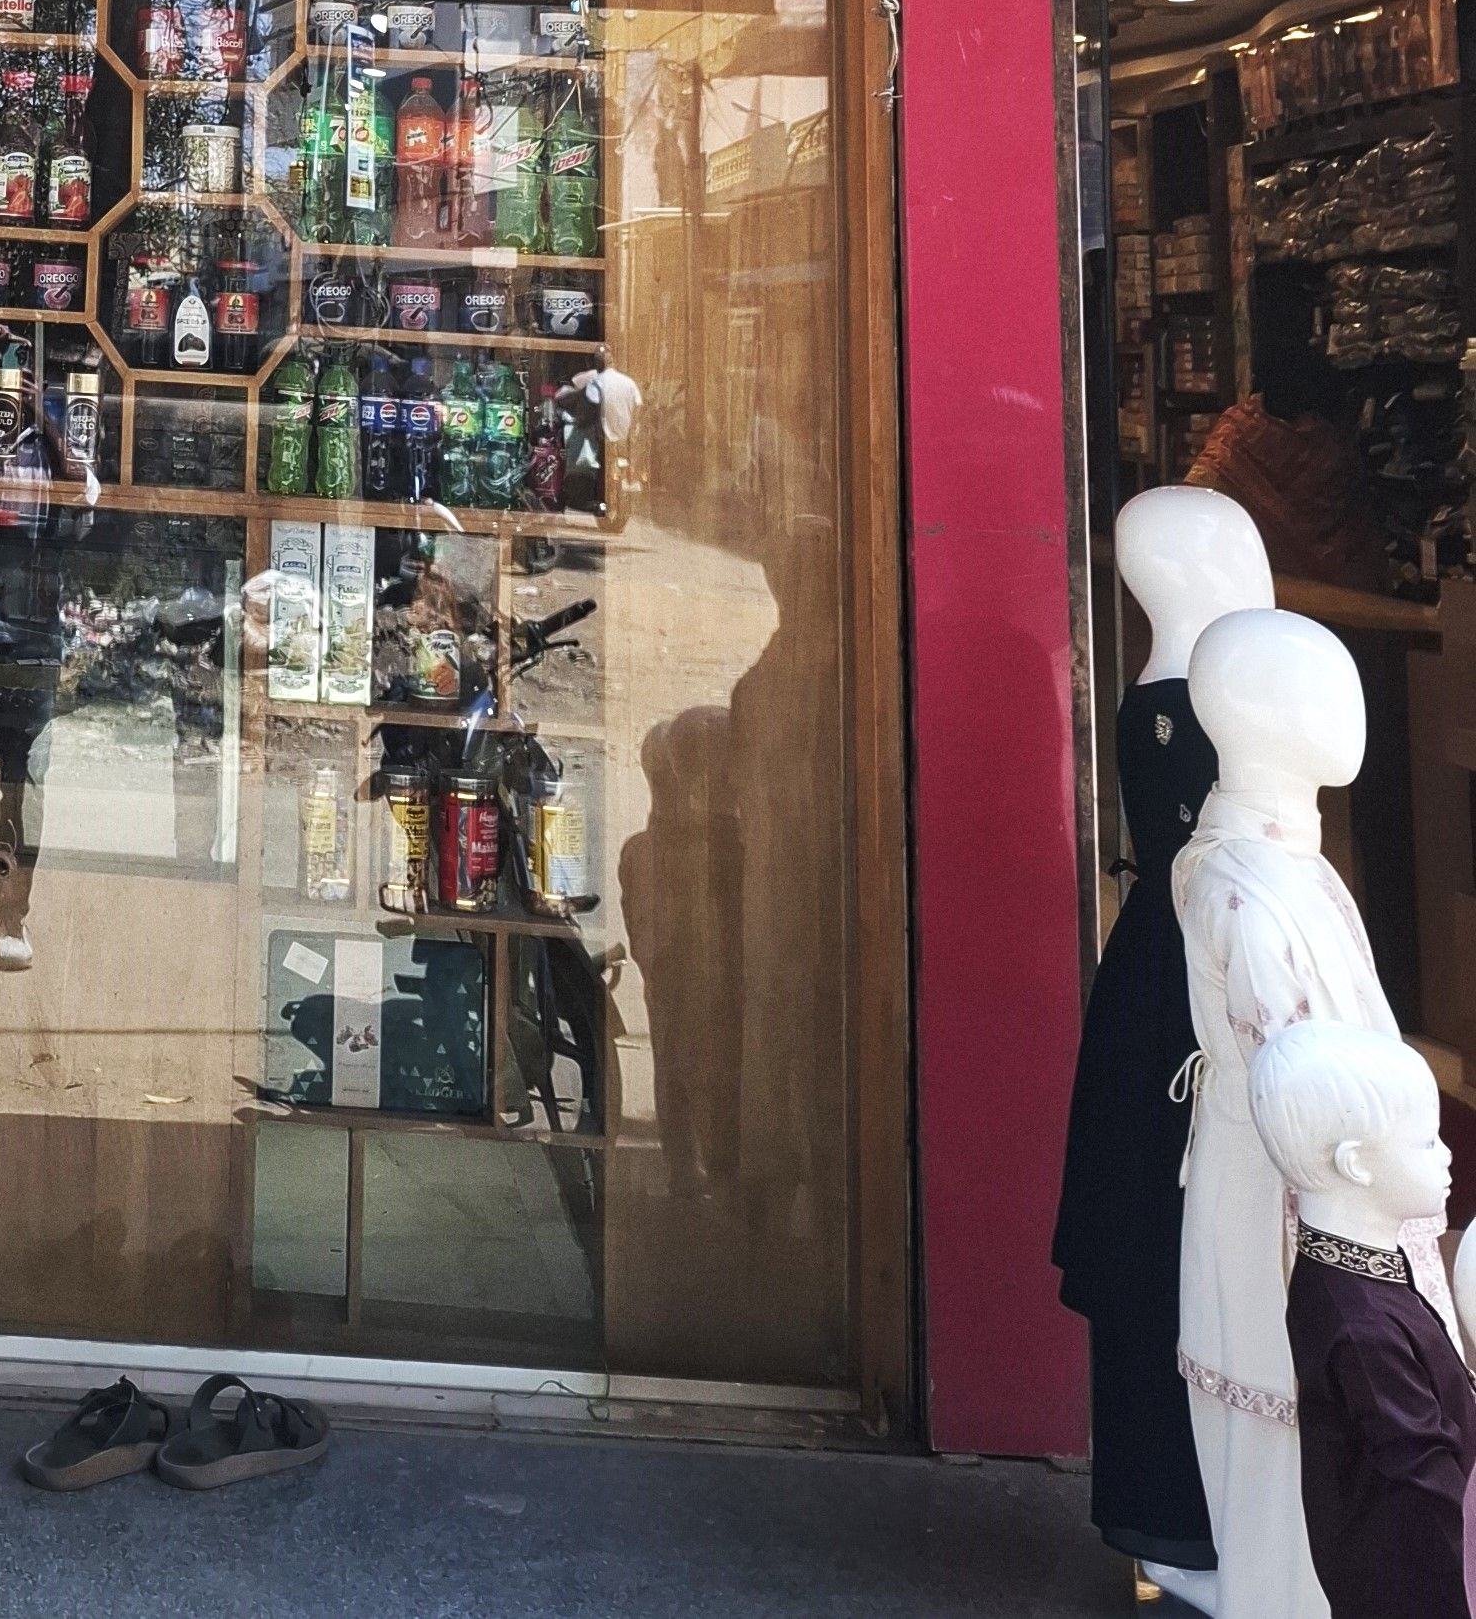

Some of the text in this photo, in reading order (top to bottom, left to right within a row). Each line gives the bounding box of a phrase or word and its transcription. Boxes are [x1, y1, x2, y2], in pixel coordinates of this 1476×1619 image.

[314, 10, 355, 23] OREOGO
[392, 12, 434, 26] OREOGO
[39, 272, 80, 285] OREOGO
[312, 284, 352, 297] OREOGO
[395, 292, 436, 305] OREOGO
[465, 294, 506, 307] OREOGO
